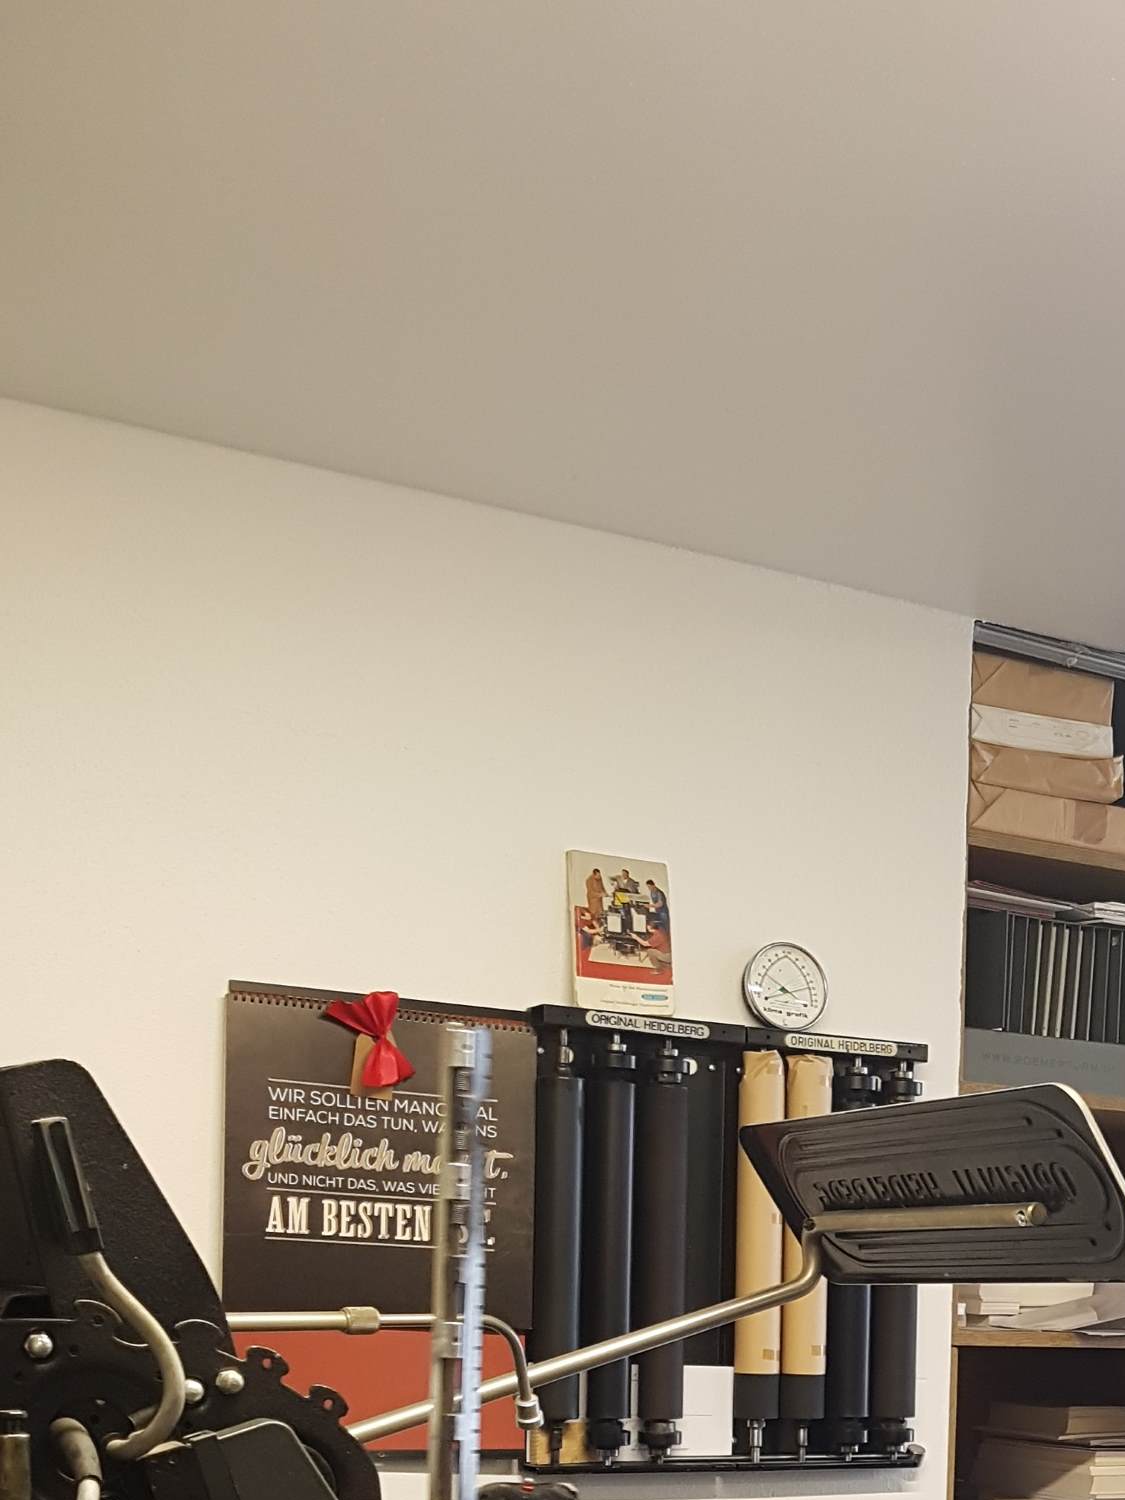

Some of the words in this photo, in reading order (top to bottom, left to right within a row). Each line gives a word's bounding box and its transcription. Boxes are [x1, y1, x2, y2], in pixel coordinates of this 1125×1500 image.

[591, 1013, 641, 1029] ORIGINAL
[643, 1020, 705, 1037] HEIDELBERG
[790, 1035, 836, 1050] ORIGINAL
[838, 1041, 893, 1055] HEIDELBERG
[268, 1086, 305, 1103] WIR
[309, 1091, 389, 1112] SOLLTEN
[268, 1105, 340, 1125] EINFACH
[343, 1113, 378, 1128] DAS
[242, 1126, 399, 1181] glücklich
[267, 1172, 299, 1186] UND
[301, 1175, 344, 1189] NICHT
[382, 1180, 416, 1194] WAS
[265, 1194, 311, 1235] AM
[321, 1198, 432, 1242] BESTEN
